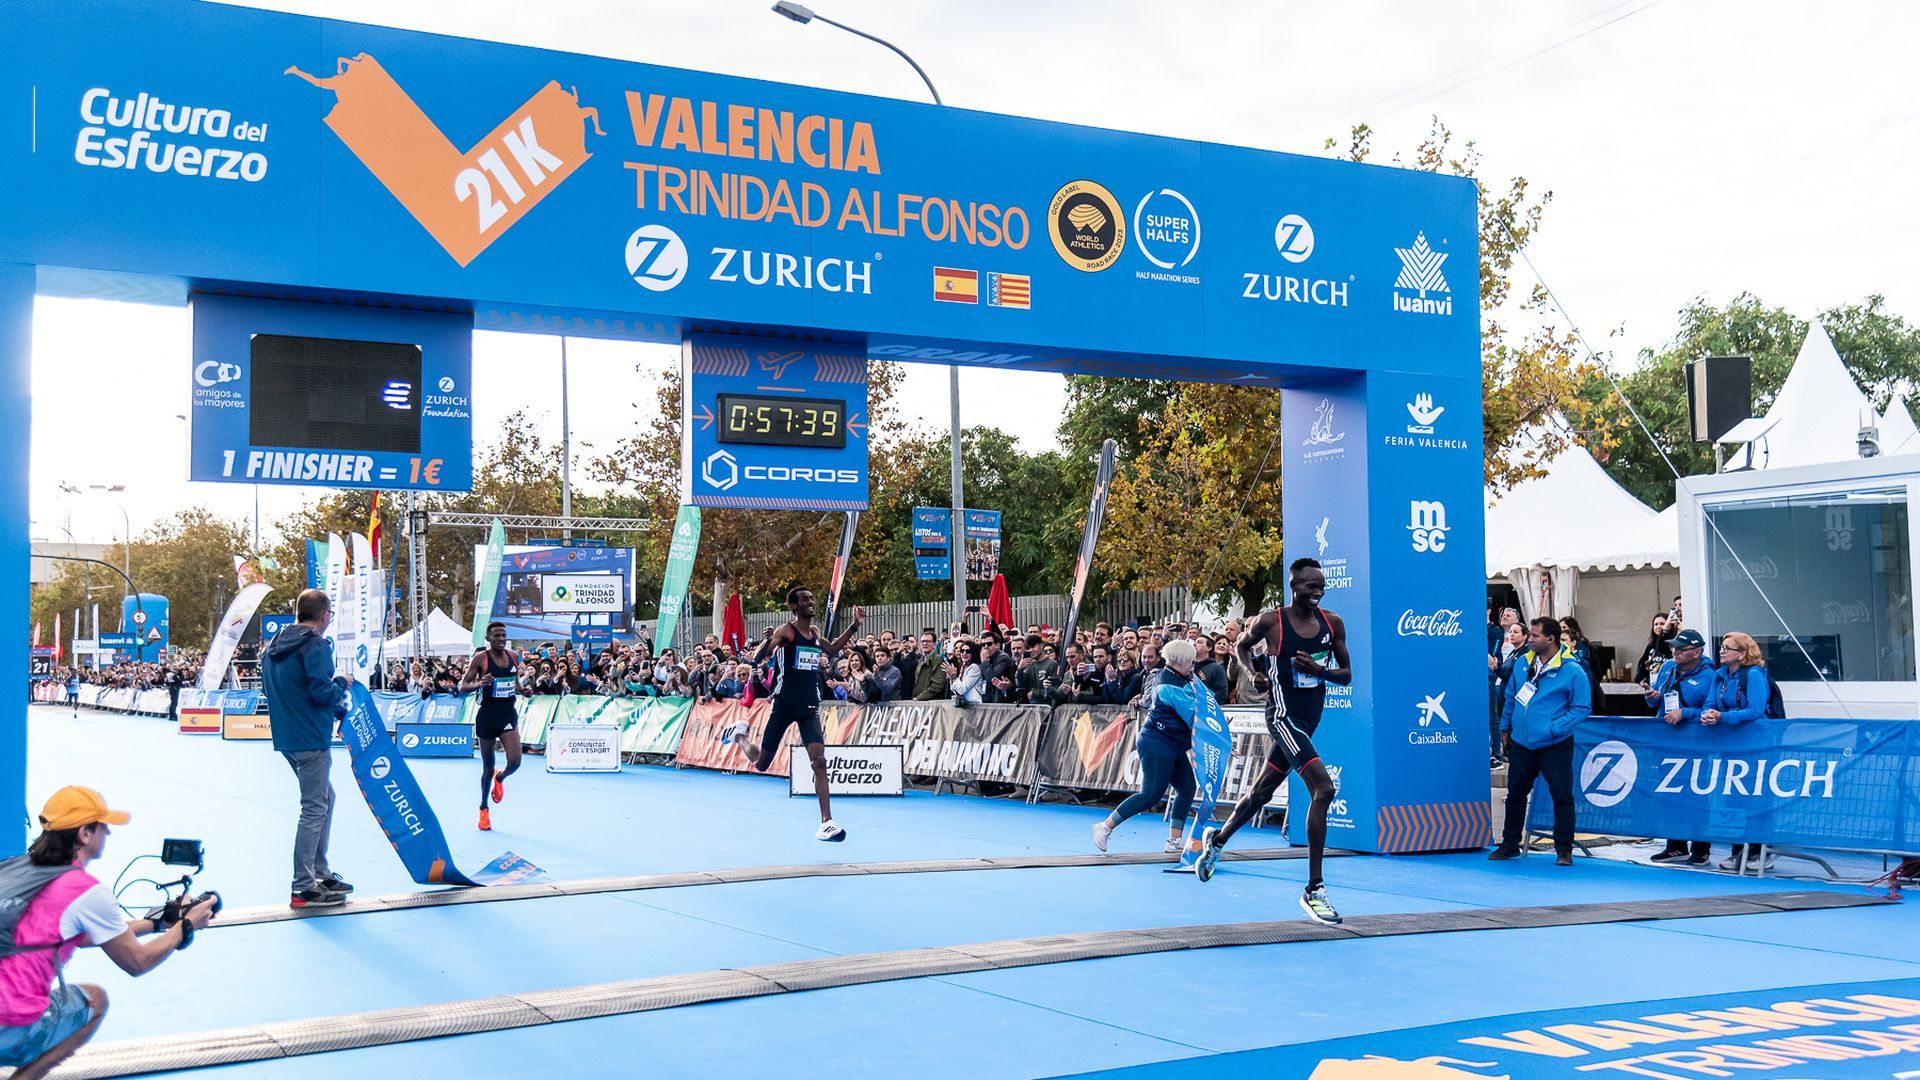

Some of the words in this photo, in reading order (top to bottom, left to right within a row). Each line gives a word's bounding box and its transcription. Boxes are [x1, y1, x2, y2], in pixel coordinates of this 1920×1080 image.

[80, 87, 231, 138] Cultura
[233, 121, 268, 143] del
[624, 91, 881, 175] VALENCIA
[74, 126, 268, 182] Esfuerzo
[623, 160, 831, 228] TRINIDAD
[837, 187, 1029, 250] ALFONSO
[1052, 197, 1062, 216] GOLD
[1061, 185, 1080, 199] LABEL
[1146, 214, 1189, 231] SUPER
[1075, 234, 1100, 243] WORLD
[1146, 228, 1189, 244] HALFS
[1070, 240, 1105, 251] ATHLETICS
[1086, 260, 1105, 269] ROAD
[1104, 249, 1118, 264] RACE
[709, 247, 872, 295] ZURICH
[1136, 271, 1151, 279] HALF
[1151, 273, 1182, 283] MARATHON
[1181, 275, 1200, 285] SERIES
[1242, 273, 1349, 307] ZURICH
[1393, 296, 1452, 316] luanvi
[196, 388, 231, 399] amigos
[426, 395, 467, 406] ZURICH
[205, 399, 246, 409] mayores
[422, 406, 470, 419] Foundation
[730, 405, 838, 437] 0:57:39
[1385, 436, 1415, 447] FERIA
[1419, 438, 1468, 450] VALENCIA
[223, 450, 235, 477] 1
[246, 451, 374, 483] FINISHER
[409, 458, 444, 485] 1€
[744, 466, 859, 483] COROS
[575, 589, 615, 597] TRINIDAD
[1397, 608, 1463, 636] Coca-Cola
[100, 637, 125, 645] luanvi
[33, 662, 49, 674] 21
[863, 706, 935, 737] VALENCIA
[423, 736, 467, 745] ZURICH
[1408, 731, 1458, 745] CaixaBank
[825, 756, 868, 771] ultura
[869, 762, 882, 770] del
[940, 740, 1018, 777] RUNNING
[812, 771, 882, 784] sfuerzo
[1655, 757, 1838, 798] ZURICH
[384, 780, 425, 837] ZURICH
[1457, 994, 1920, 1058] VALENCIA
